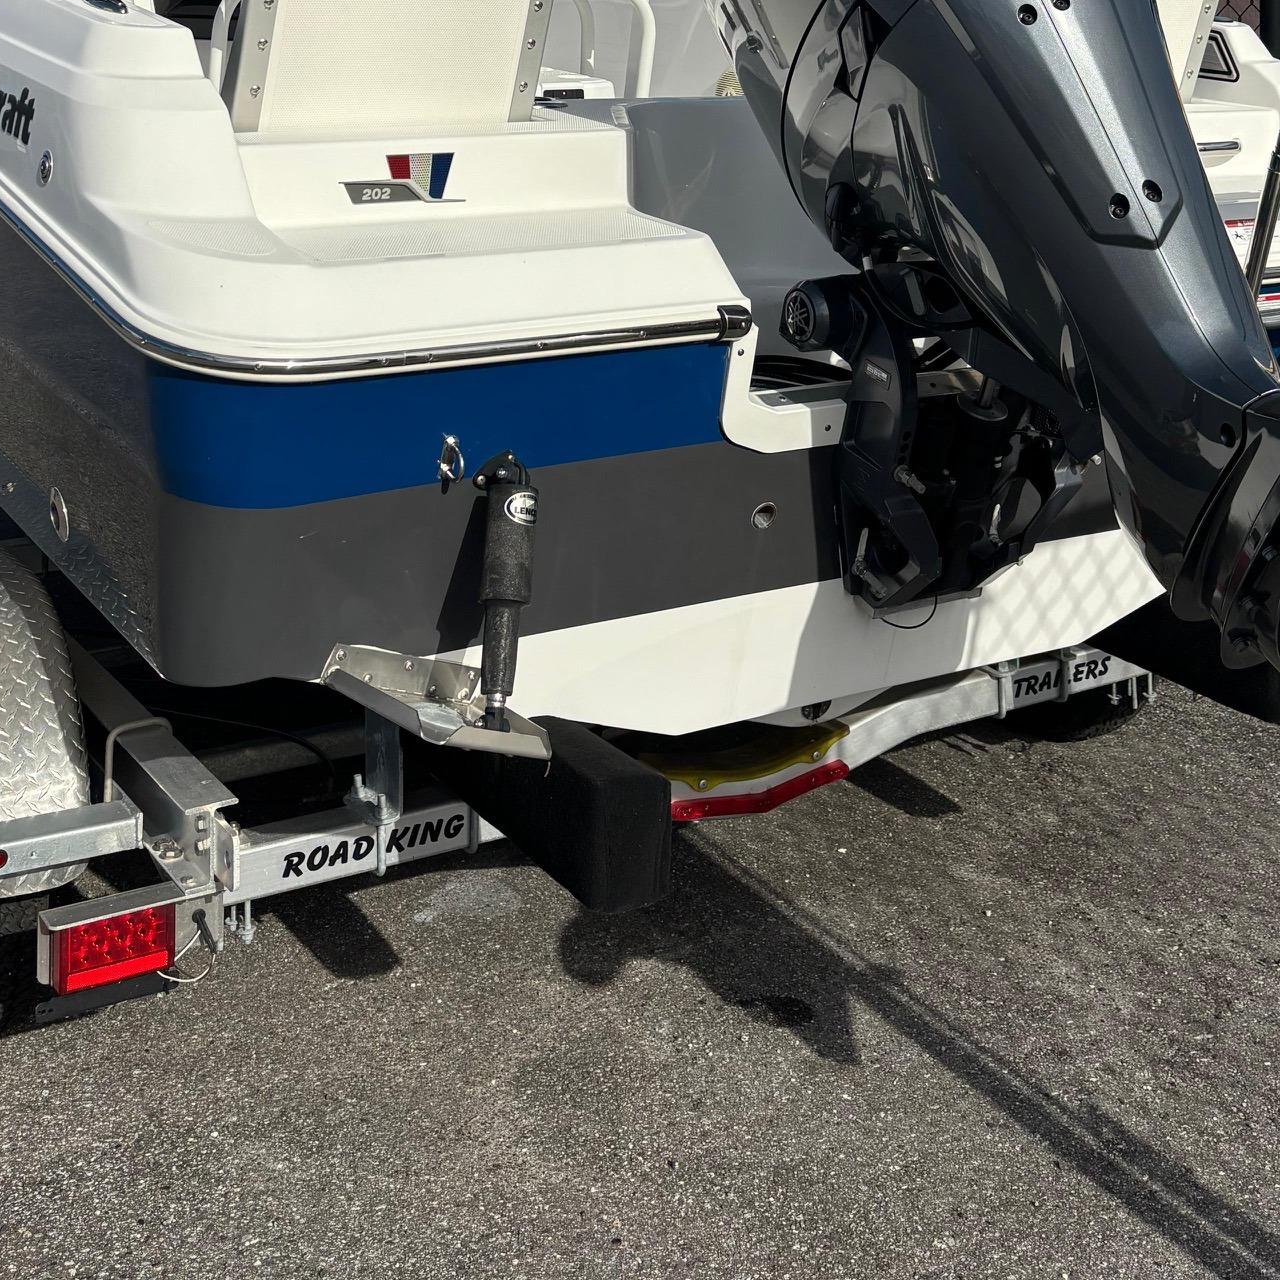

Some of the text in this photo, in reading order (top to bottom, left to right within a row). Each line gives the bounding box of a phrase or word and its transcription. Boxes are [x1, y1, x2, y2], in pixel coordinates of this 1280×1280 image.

[361, 187, 391, 200] 202
[514, 506, 537, 516] LENC
[1013, 656, 1111, 698] TRAIERS
[282, 814, 465, 878] ROAD KING
